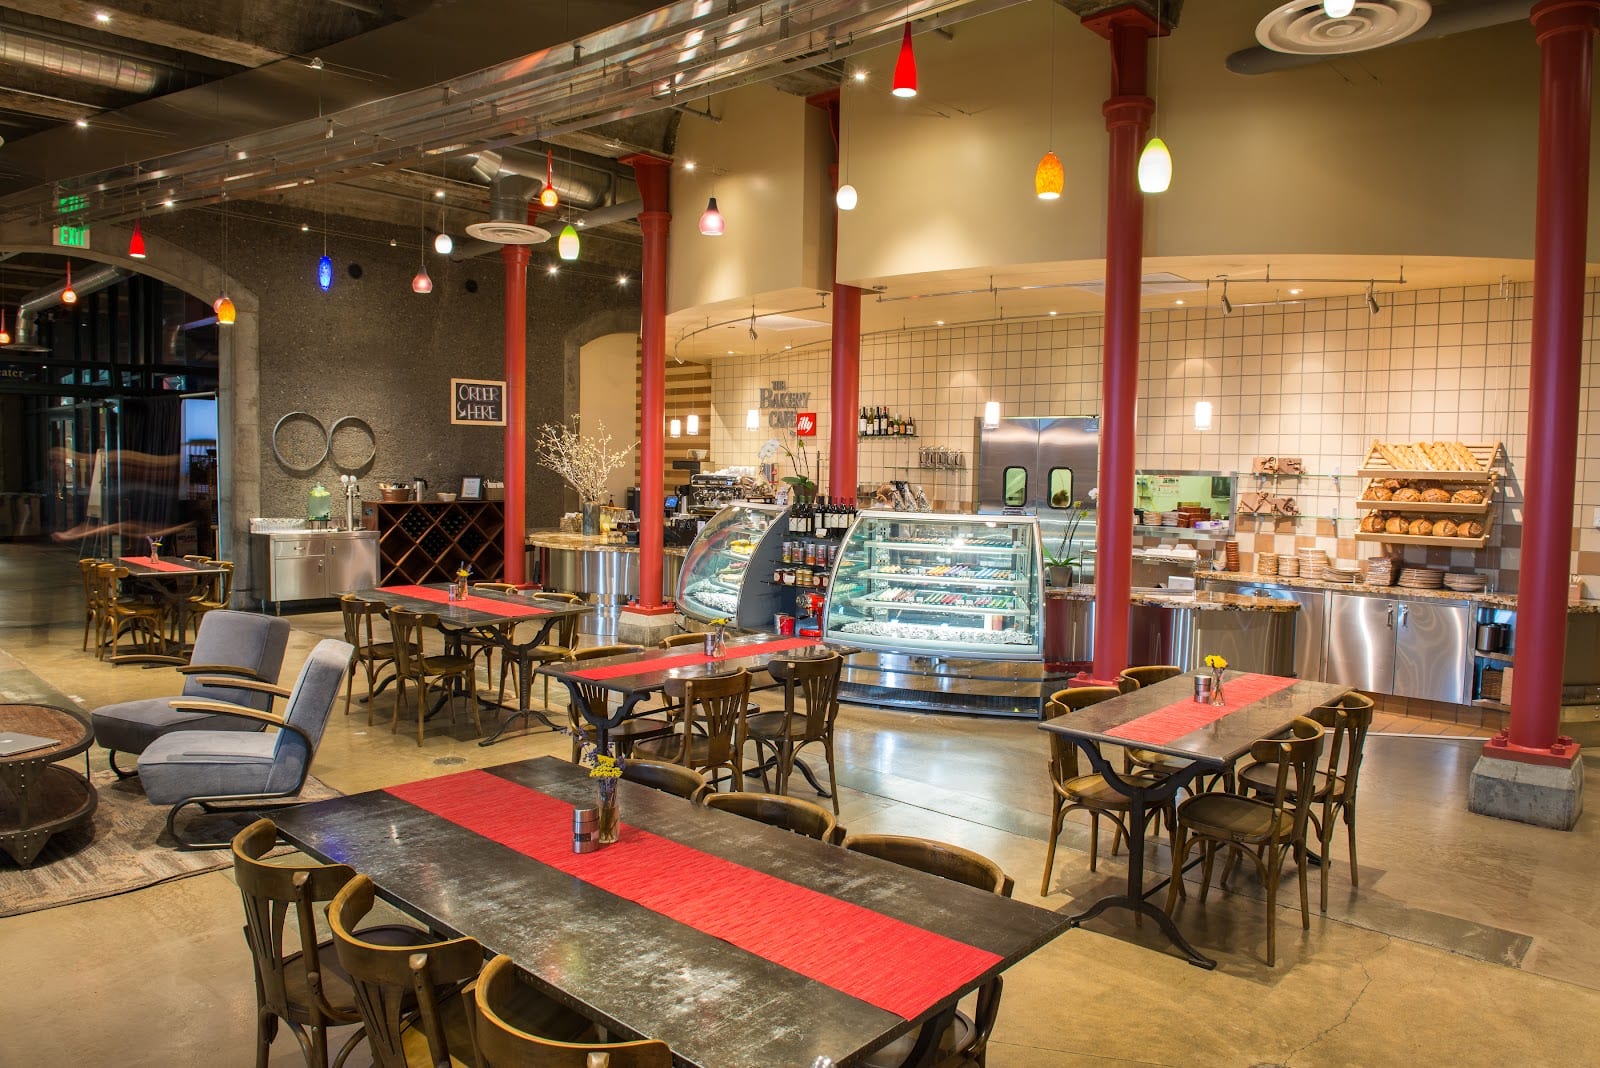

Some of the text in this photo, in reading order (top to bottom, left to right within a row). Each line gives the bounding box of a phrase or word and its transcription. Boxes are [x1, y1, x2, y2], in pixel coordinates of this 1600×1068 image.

[59, 226, 86, 247] EXIT
[0, 369, 24, 377] ater
[459, 384, 500, 401] ORDER
[760, 388, 811, 409] BAKERY
[467, 404, 498, 420] HERE
[797, 416, 813, 433] illy
